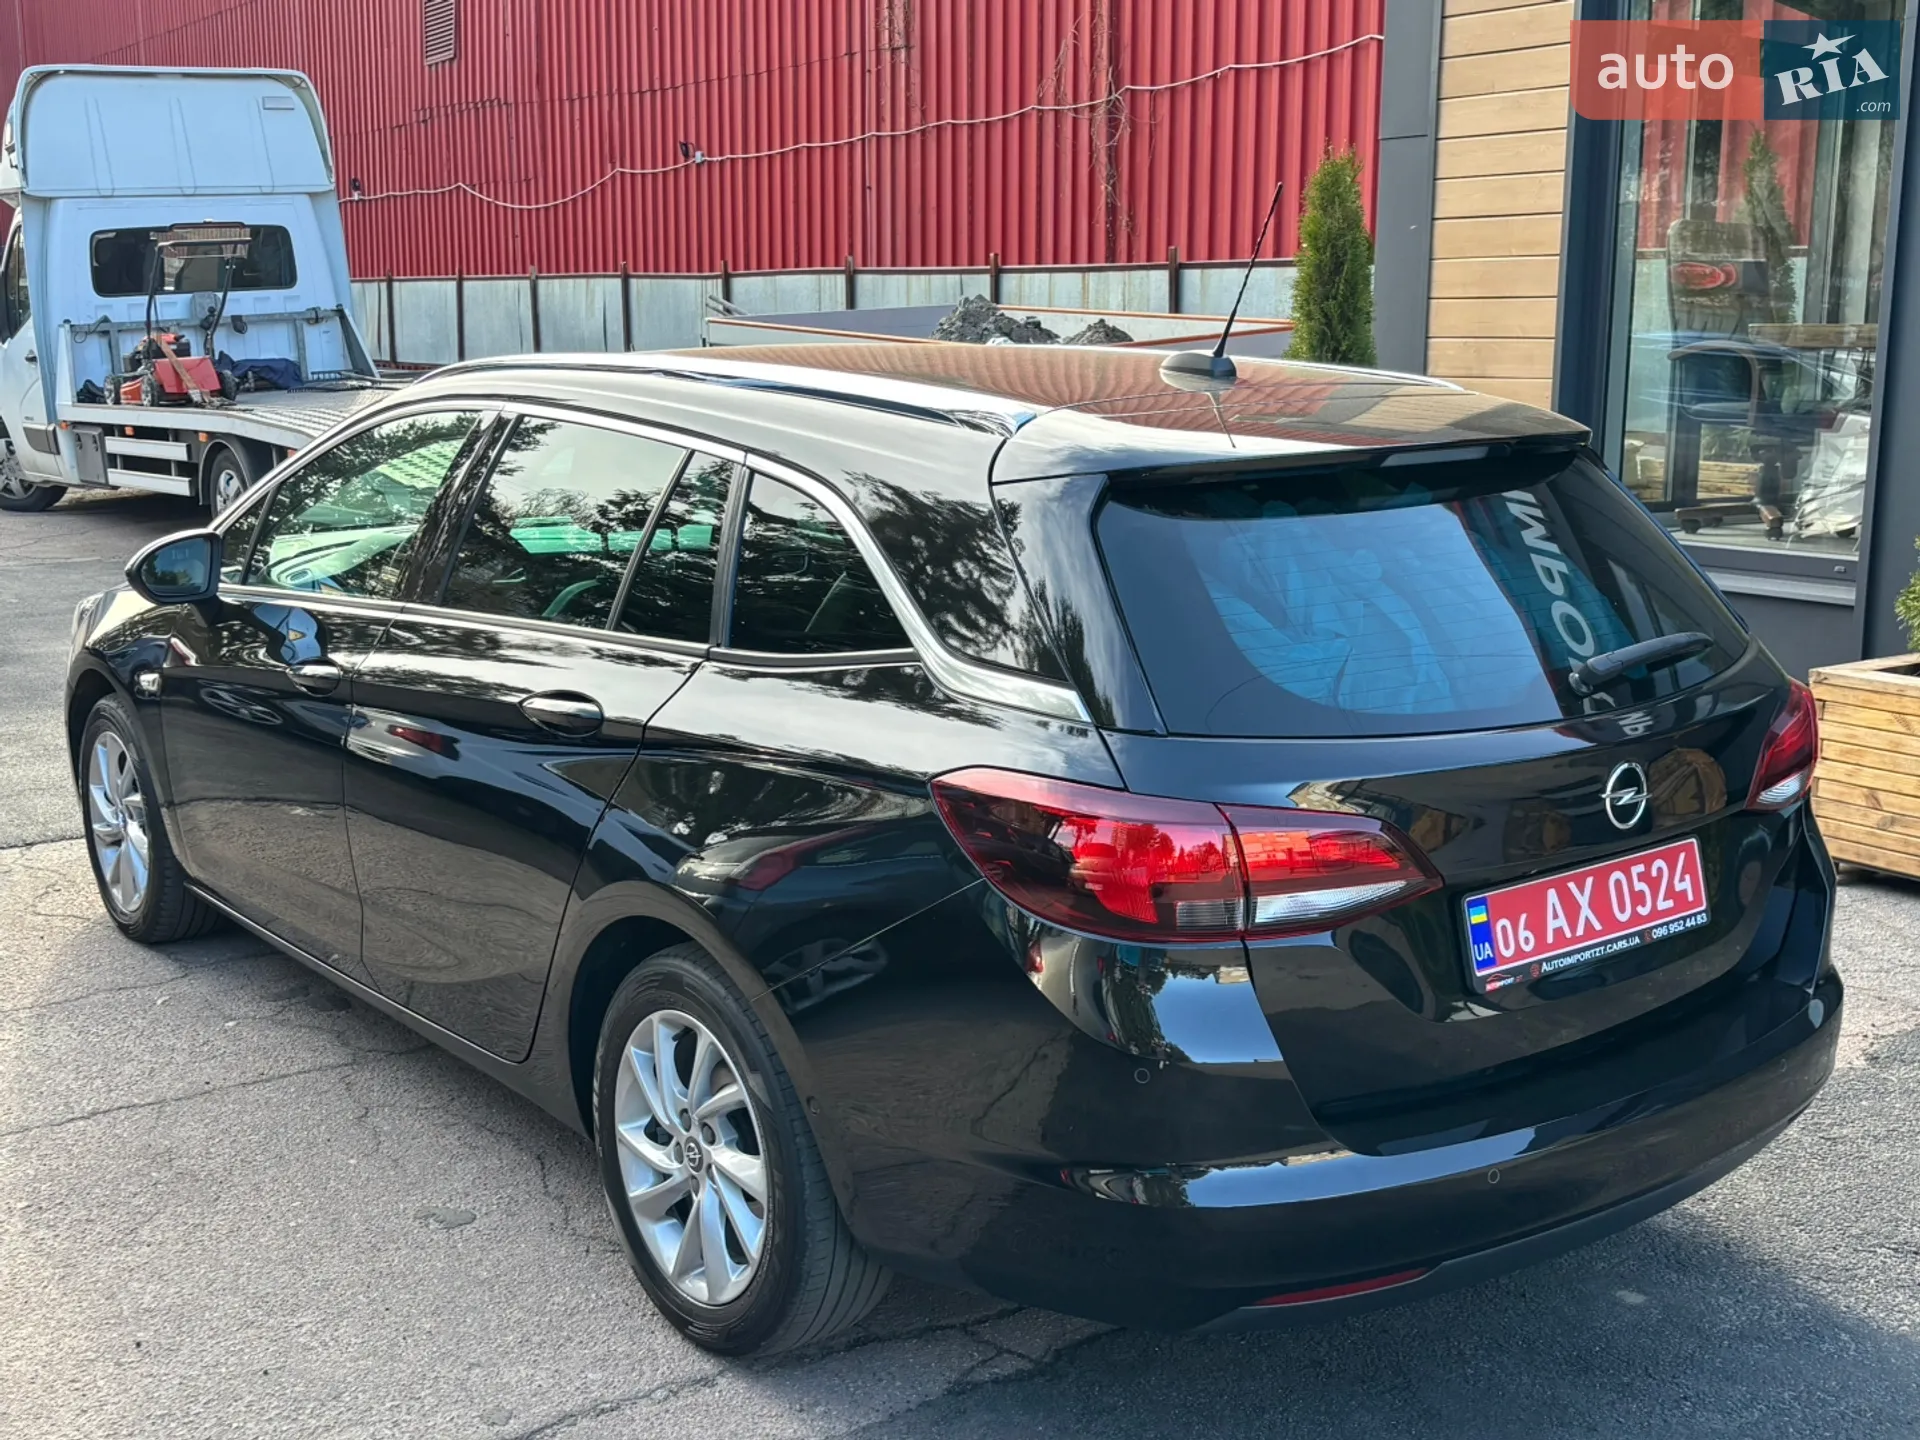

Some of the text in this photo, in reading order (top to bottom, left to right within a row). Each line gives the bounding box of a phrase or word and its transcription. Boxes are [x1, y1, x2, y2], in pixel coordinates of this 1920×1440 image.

[1495, 851, 1695, 958] 06 AX 0524
[1652, 925, 1668, 939] 096
[1669, 920, 1685, 934] 952
[1474, 941, 1494, 961] UA
